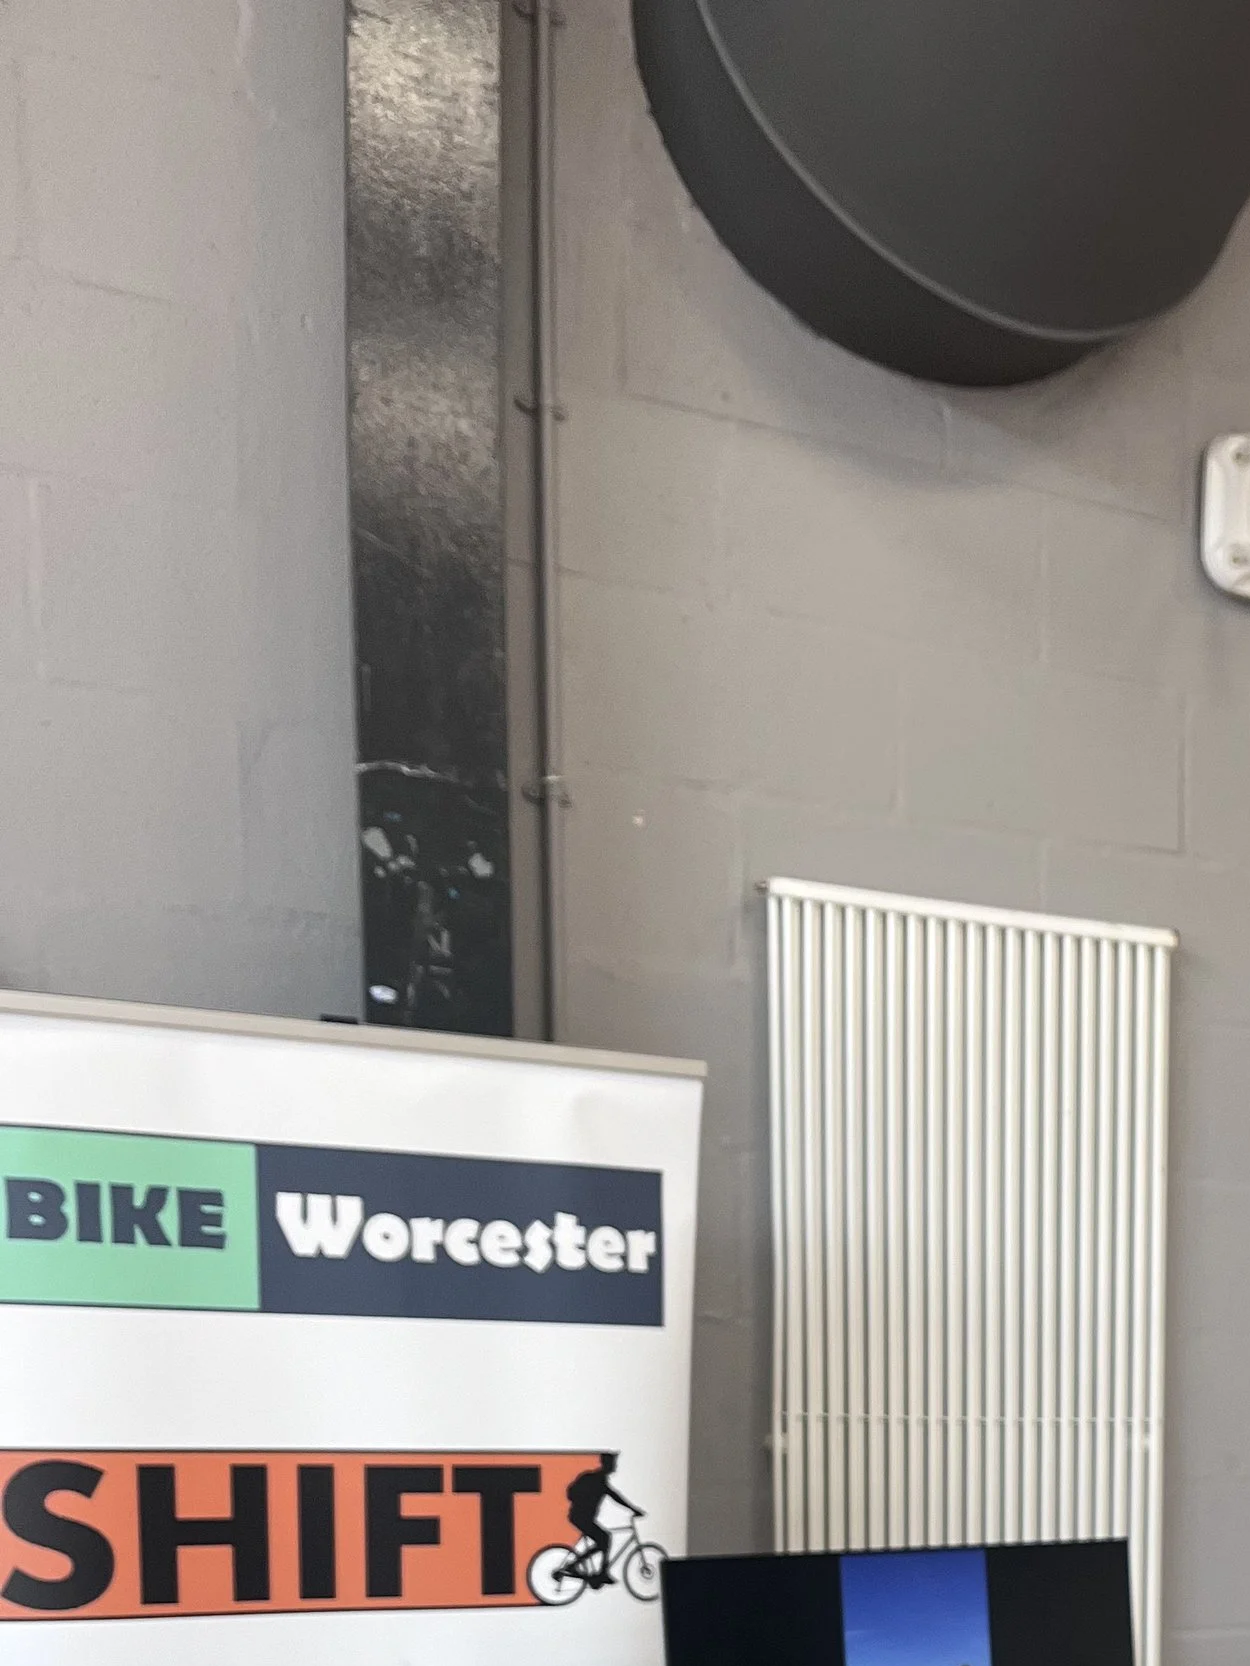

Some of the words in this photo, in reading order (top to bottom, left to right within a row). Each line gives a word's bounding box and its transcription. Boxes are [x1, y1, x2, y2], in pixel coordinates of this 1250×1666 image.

[5, 1178, 227, 1251] BIKE
[274, 1190, 657, 1274] Worcester
[1, 1459, 542, 1611] SHIFT
